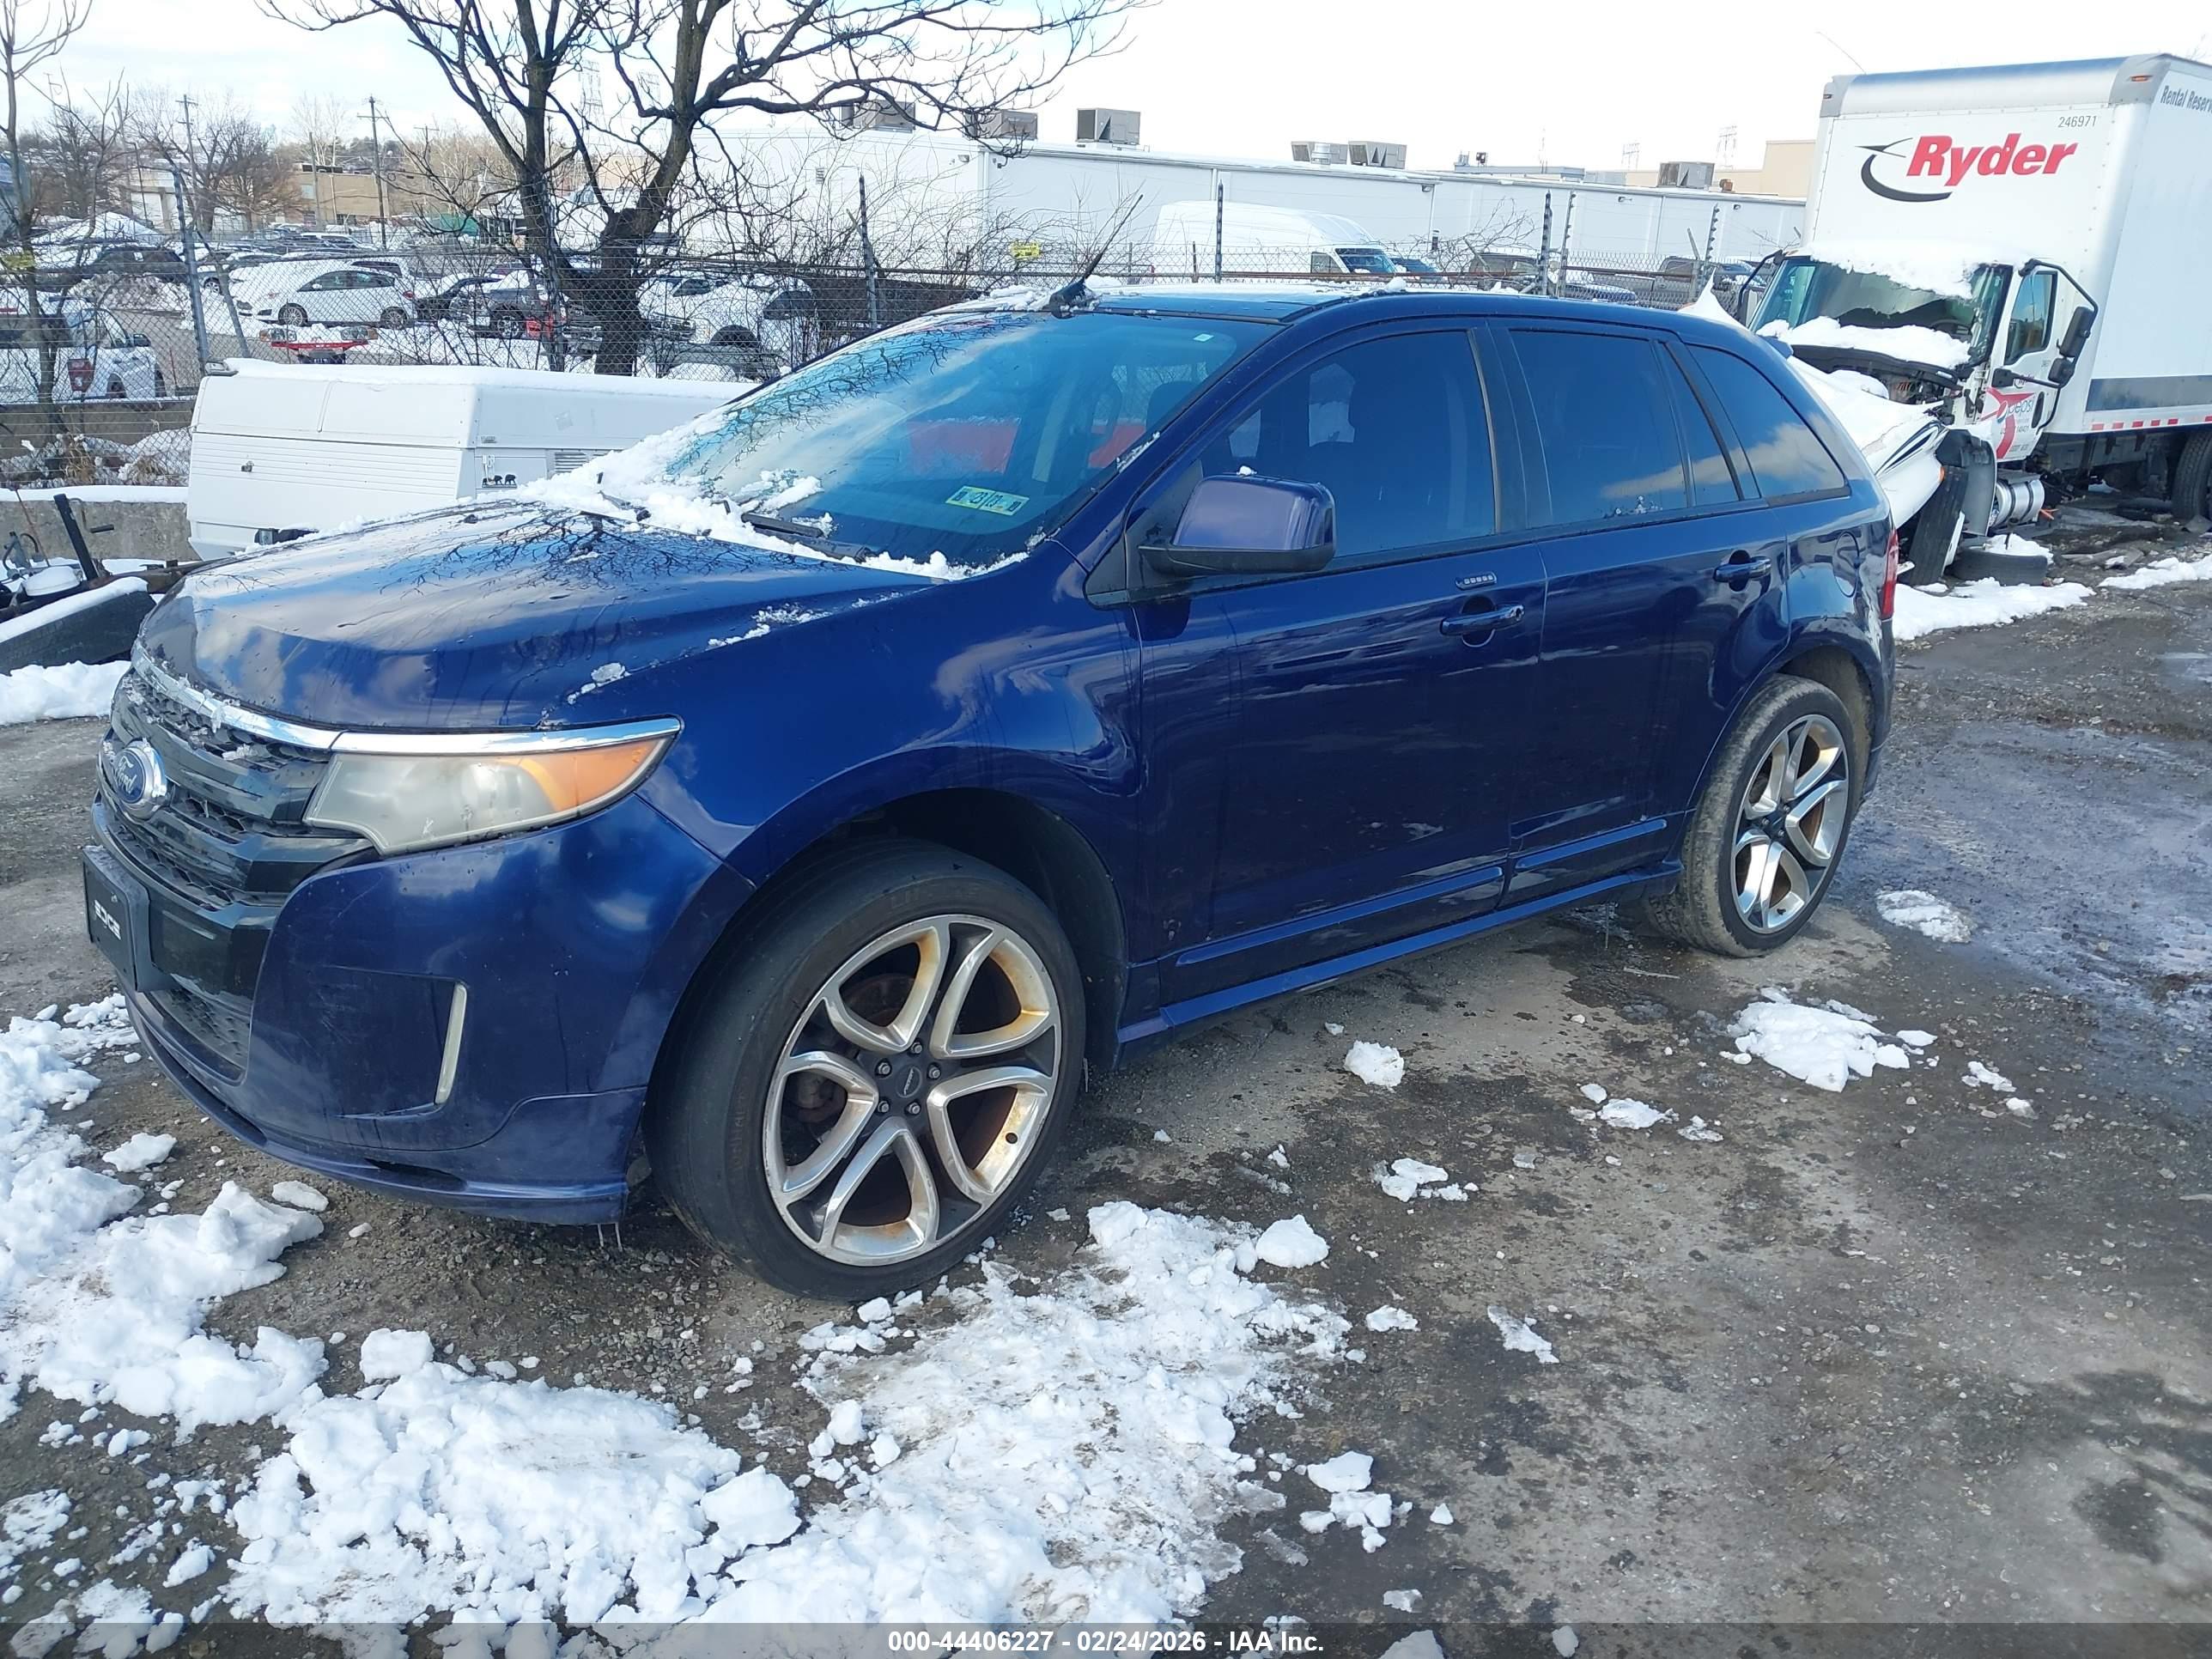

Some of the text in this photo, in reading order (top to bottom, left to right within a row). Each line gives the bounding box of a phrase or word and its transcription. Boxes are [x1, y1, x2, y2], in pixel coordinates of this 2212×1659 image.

[2160, 85, 2189, 108] Rental
[2057, 115, 2097, 128] 246971
[1905, 132, 2078, 186] Ryder
[115, 755, 137, 795] Ford
[94, 899, 121, 940] EDGE
